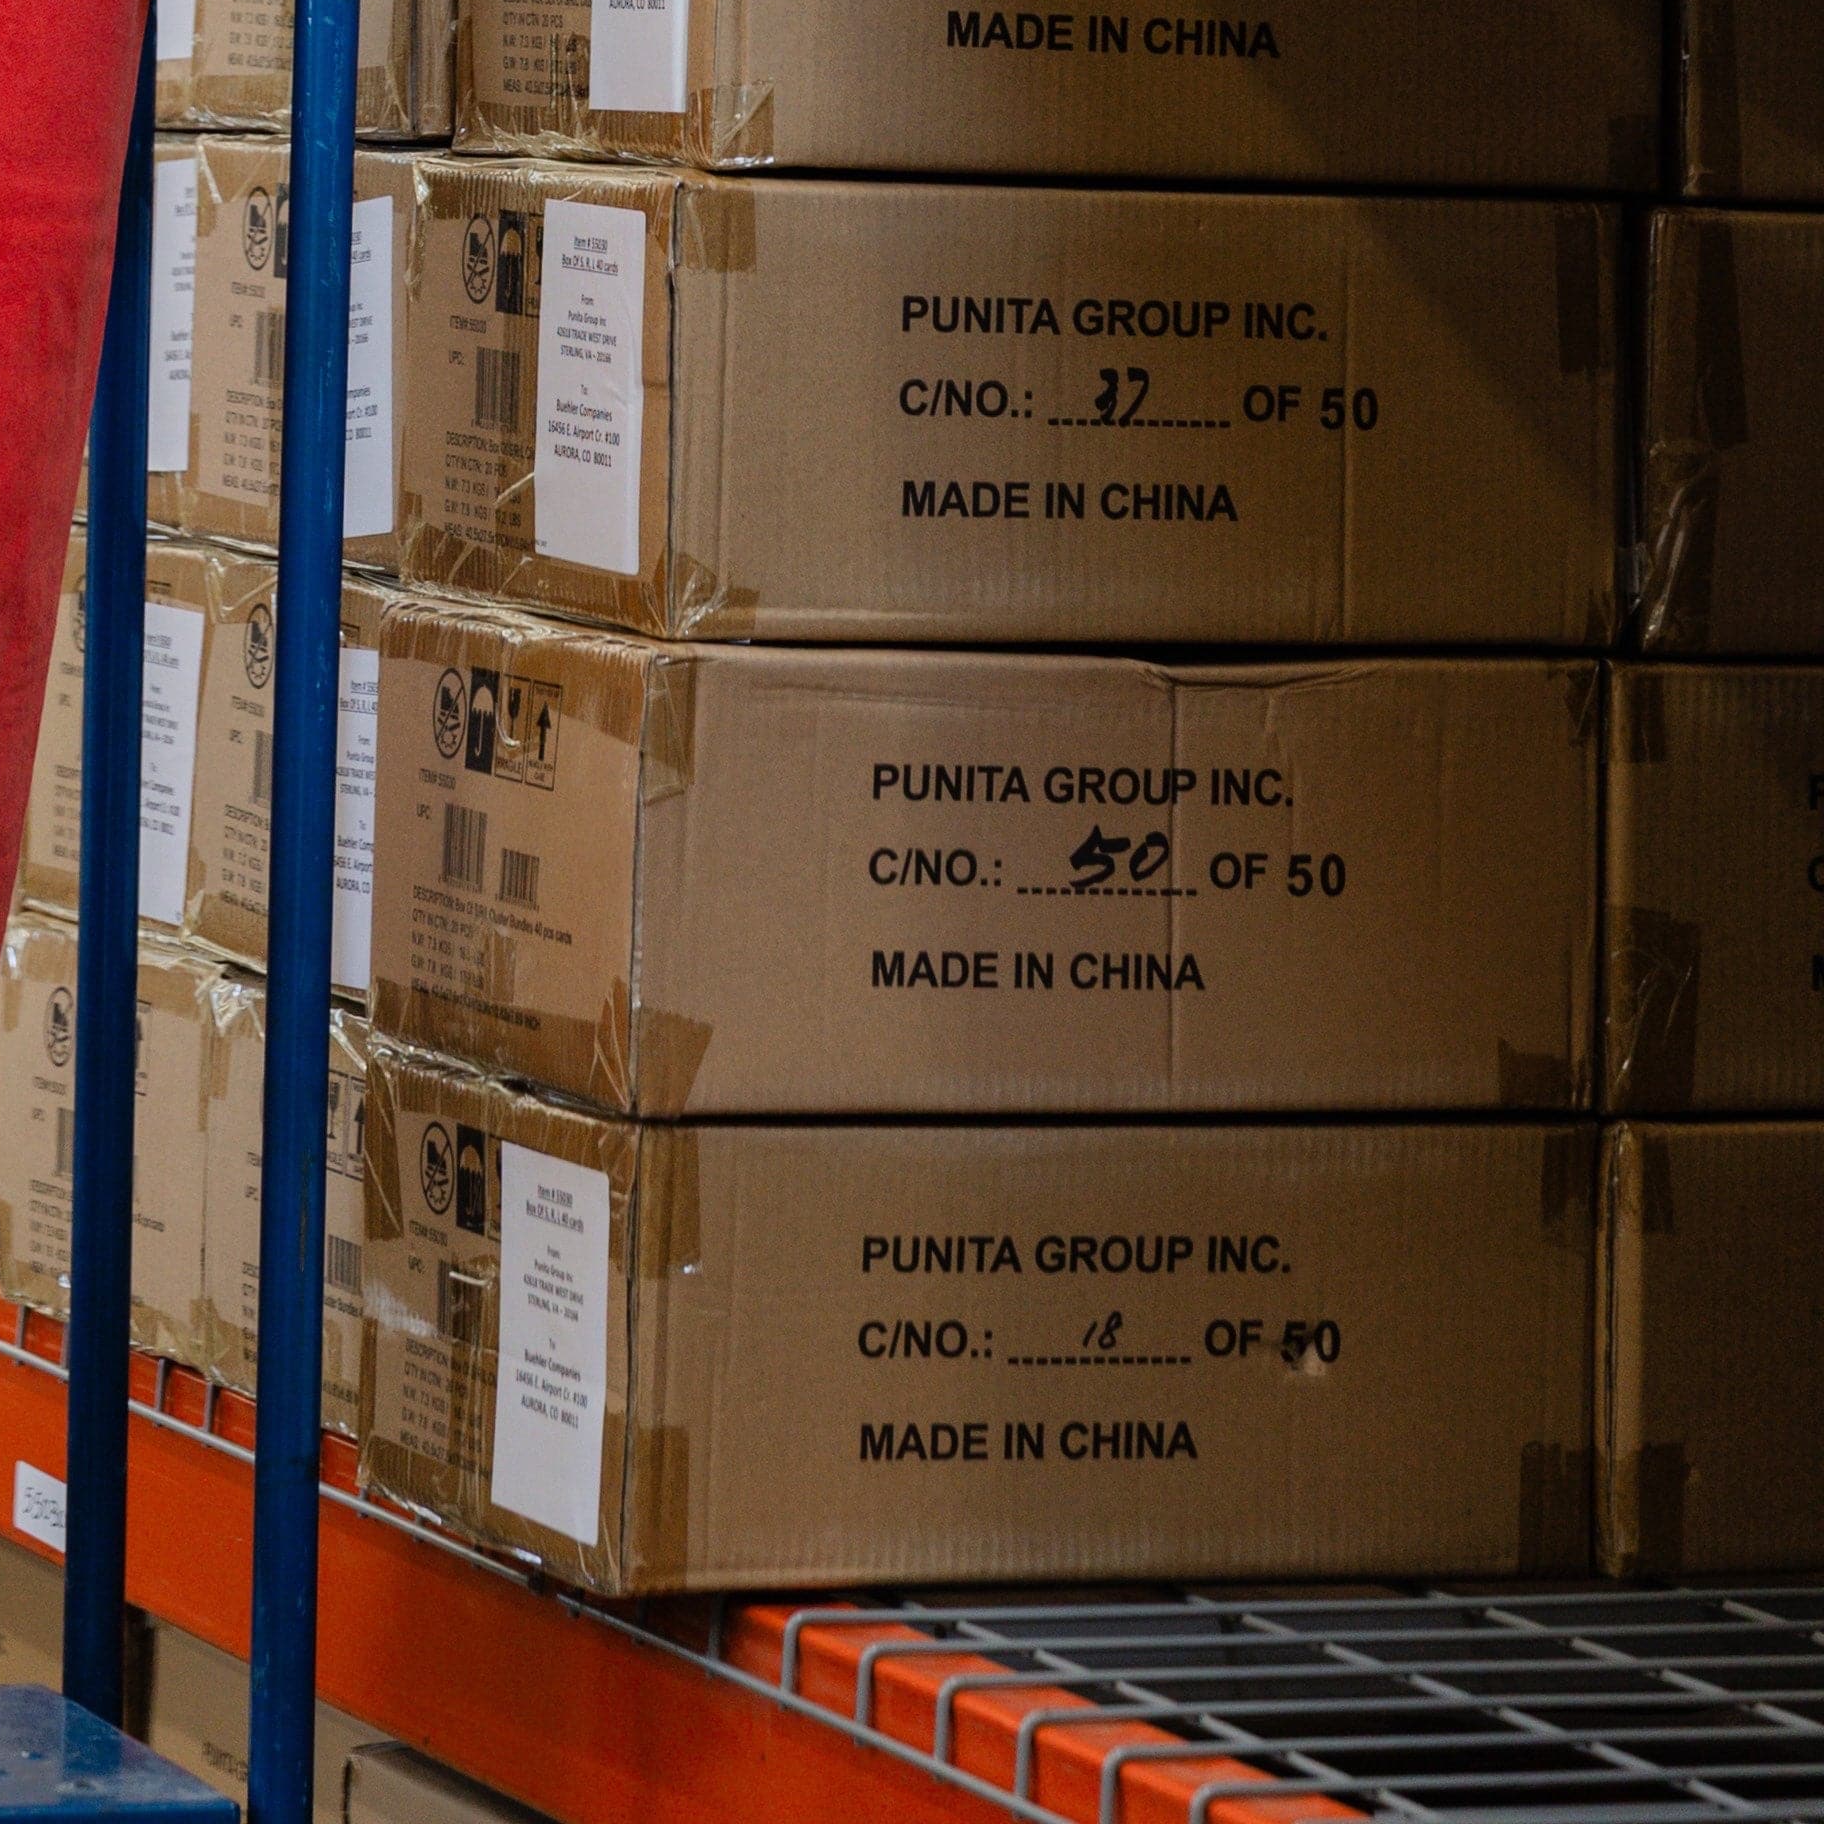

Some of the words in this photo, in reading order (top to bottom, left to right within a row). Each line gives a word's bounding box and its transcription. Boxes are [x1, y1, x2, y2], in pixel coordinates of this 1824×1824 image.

[947, 10, 1073, 51] MADE
[1089, 16, 1128, 52] IN
[1144, 18, 1280, 58] CHINA
[901, 295, 1060, 335] PUNITA
[1073, 299, 1230, 338] GROUP
[1244, 302, 1327, 341] INC.
[580, 403, 612, 422] Companies
[899, 378, 1033, 418] C/NO.:
[1243, 385, 1300, 422] OF
[1320, 388, 1378, 431] 50
[901, 480, 1029, 518] MADE
[1046, 483, 1084, 520] IN
[1100, 484, 1238, 522] CHINA
[872, 764, 1030, 802] PUNITA
[1043, 766, 1196, 805] GROUP
[1211, 768, 1293, 807] INC.
[869, 847, 1002, 887] C/NO.:
[1070, 824, 1170, 888] 50
[1210, 853, 1267, 890] OF
[1287, 854, 1345, 897] 50
[872, 950, 998, 988] MADE
[1015, 953, 1054, 990] IN
[1070, 953, 1205, 991] CHINA
[861, 1235, 1022, 1273] PUNITA
[1034, 1235, 1193, 1274] GROUP
[1207, 1235, 1291, 1273] INC.
[858, 1320, 993, 1359] C/NO.:
[1204, 1318, 1263, 1355] OF
[1281, 1320, 1341, 1364] 50
[860, 1423, 988, 1461] MADE
[1004, 1422, 1044, 1460] IN
[1059, 1422, 1198, 1461] CHINA
